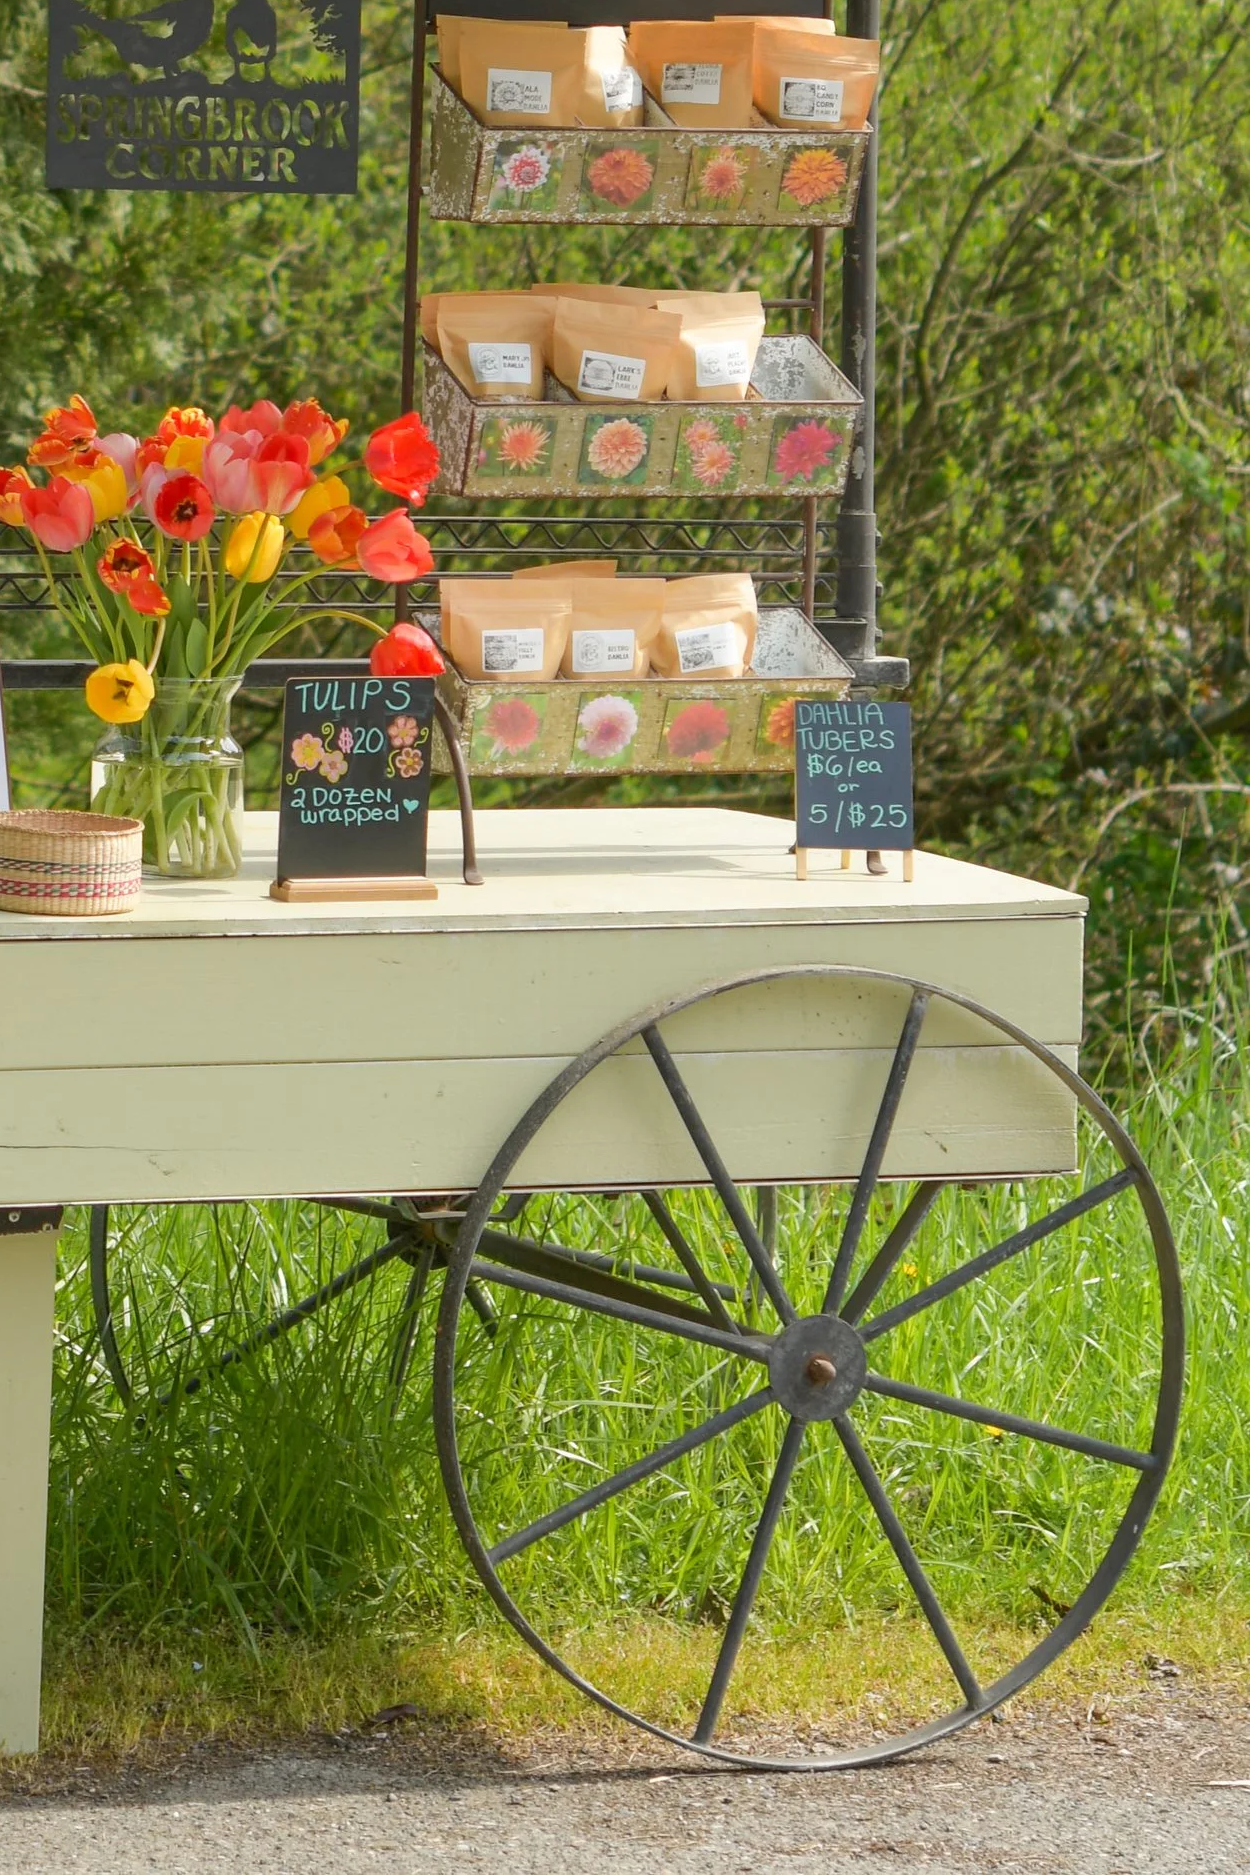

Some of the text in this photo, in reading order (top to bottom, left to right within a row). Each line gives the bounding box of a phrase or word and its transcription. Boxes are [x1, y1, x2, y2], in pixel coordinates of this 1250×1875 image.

[56, 94, 350, 150] SPRINGBROOK
[105, 142, 299, 183] CORNER
[295, 680, 411, 713] TULIPS
[799, 702, 885, 726] DAHLIA
[338, 726, 385, 754] $20
[797, 727, 895, 753] TUBERS
[290, 788, 307, 809] 2
[837, 783, 860, 793] or
[300, 804, 400, 827] wrapped
